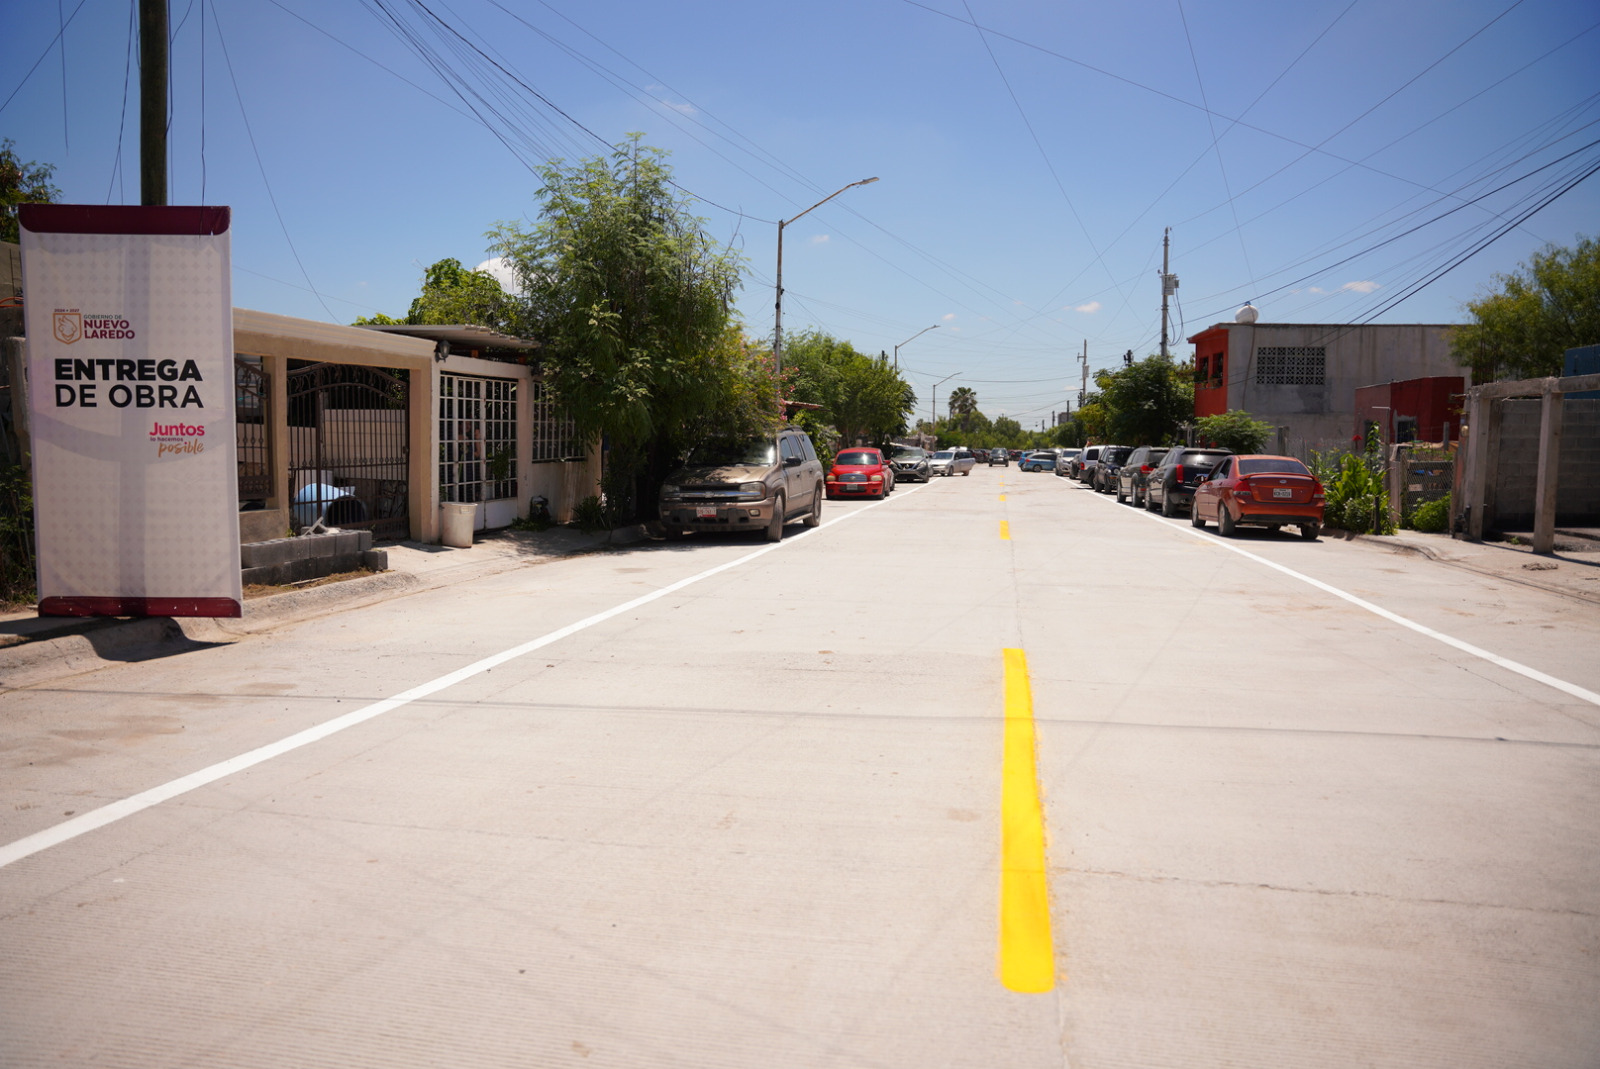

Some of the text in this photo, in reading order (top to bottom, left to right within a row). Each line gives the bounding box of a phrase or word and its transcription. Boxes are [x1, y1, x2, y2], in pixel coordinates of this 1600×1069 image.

[84, 320, 130, 329] NUEVO
[84, 330, 135, 339] LAREDO
[55, 358, 203, 382] ENTREGA
[55, 384, 204, 408] DE OBRA
[149, 422, 205, 436] Juntos
[158, 438, 204, 458] posible
